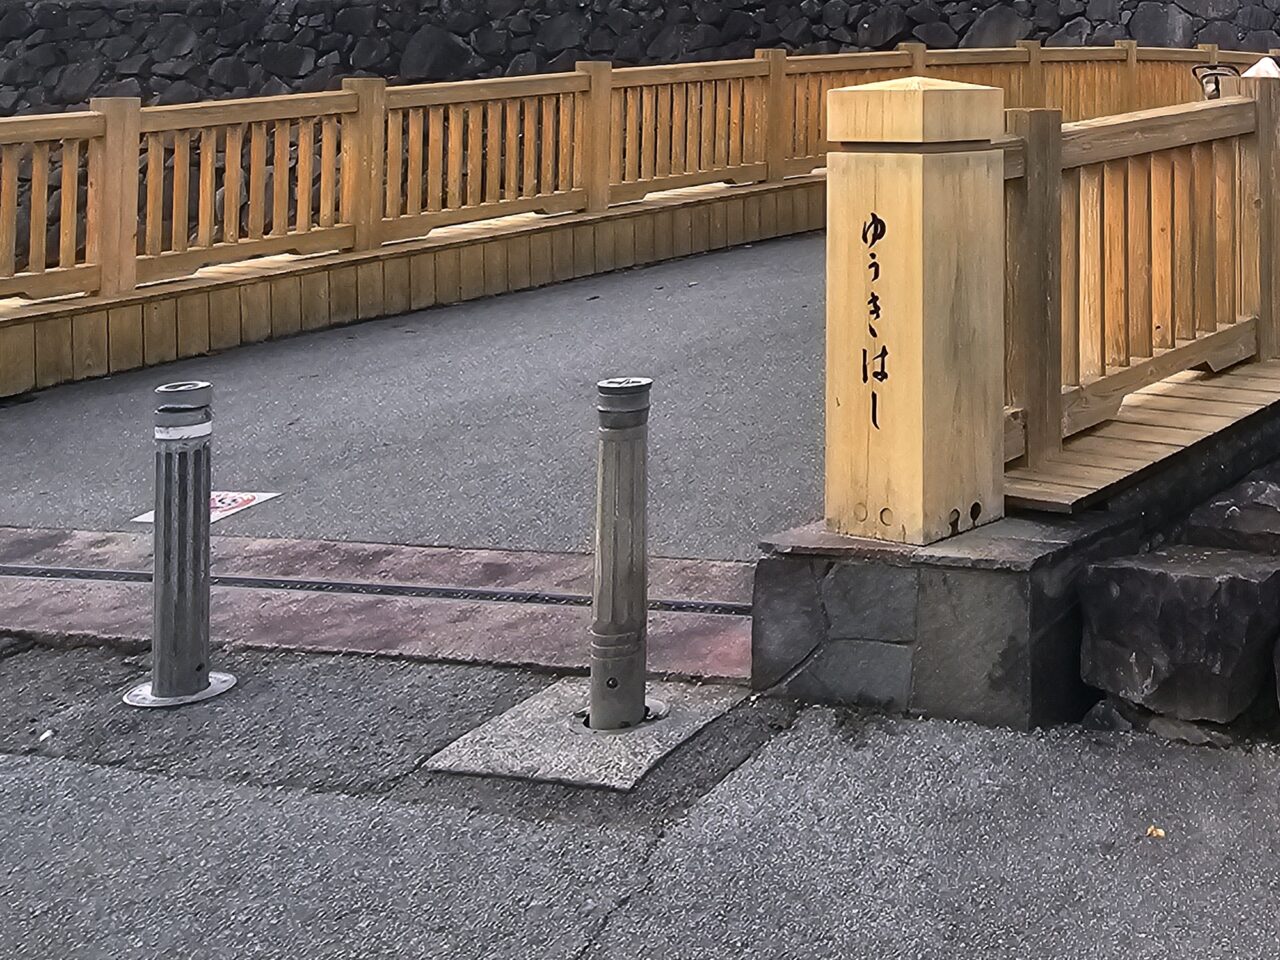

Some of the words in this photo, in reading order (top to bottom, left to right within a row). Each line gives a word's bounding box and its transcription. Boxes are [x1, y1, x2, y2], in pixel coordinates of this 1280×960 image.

[861, 212, 889, 430] ゆうきはし
